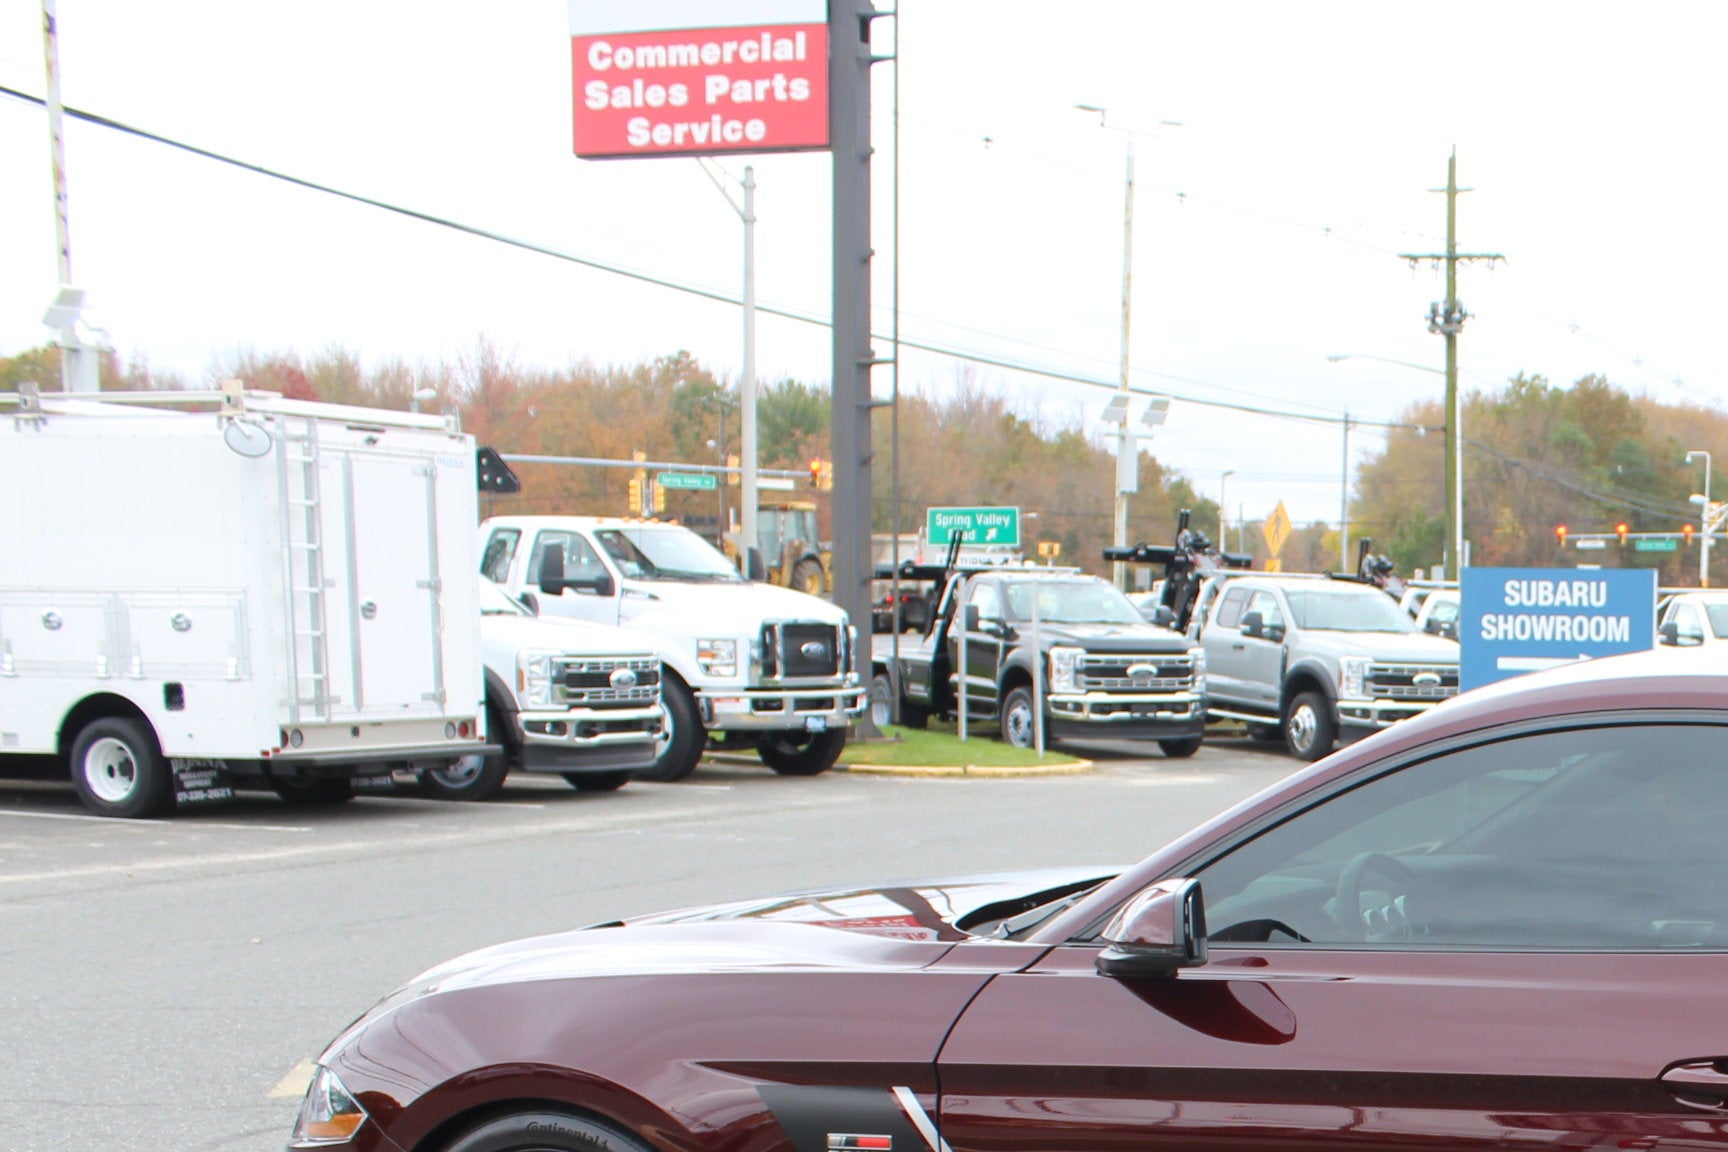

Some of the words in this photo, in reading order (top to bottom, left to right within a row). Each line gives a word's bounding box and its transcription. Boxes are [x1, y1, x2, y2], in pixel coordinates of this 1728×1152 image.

[587, 31, 807, 71] Commercial
[584, 78, 689, 110] Sales
[705, 73, 810, 105] Parts
[626, 114, 767, 146] Service
[935, 513, 971, 528] Spring
[975, 513, 1011, 528] Valley
[947, 528, 976, 541] Rad
[1503, 579, 1607, 607] SUBARU
[1480, 614, 1630, 642] SHOWROOM
